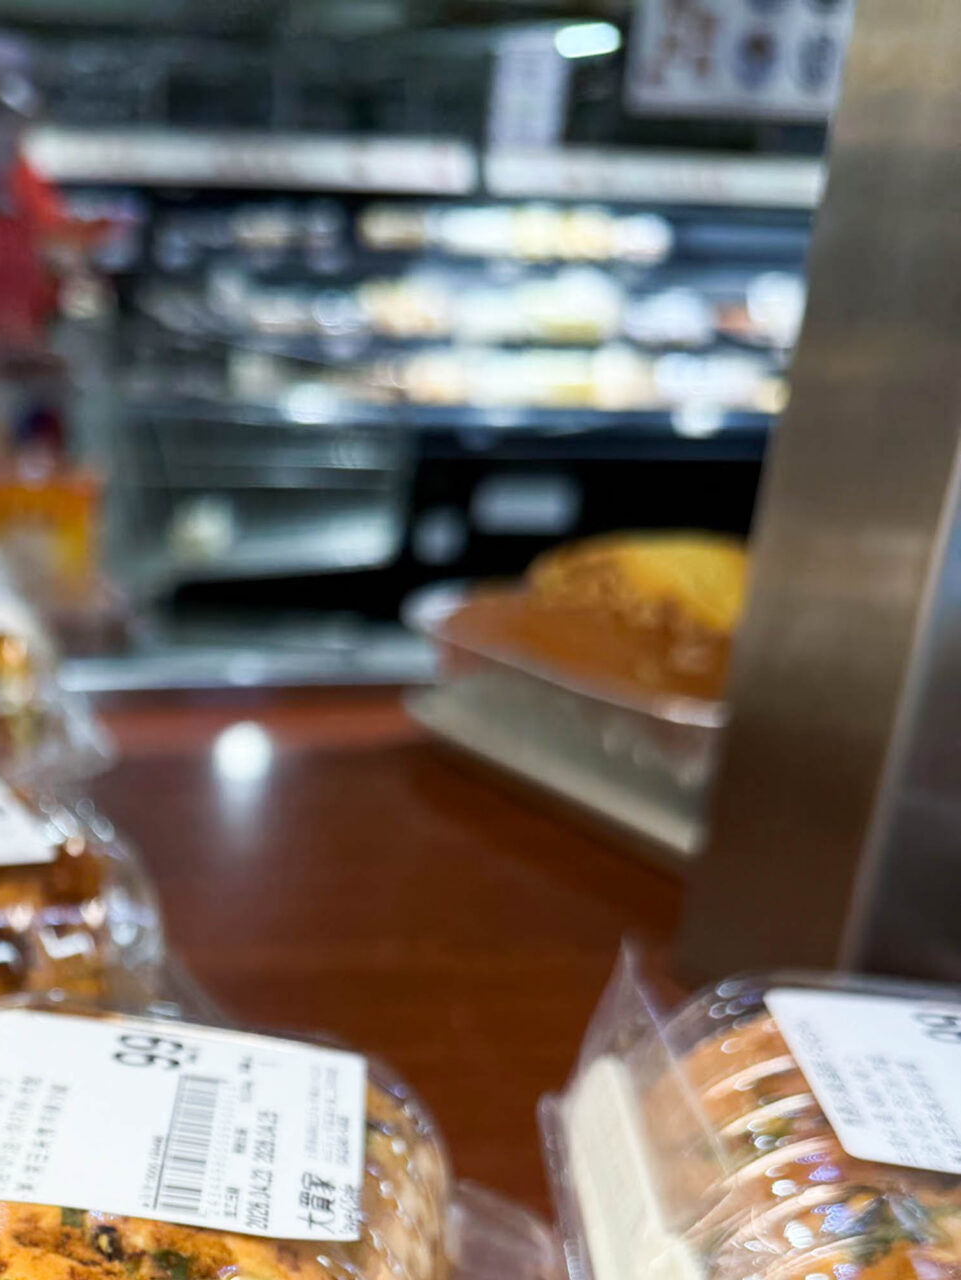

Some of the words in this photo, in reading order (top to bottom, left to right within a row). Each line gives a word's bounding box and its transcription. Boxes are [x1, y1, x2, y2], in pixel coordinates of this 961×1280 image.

[115, 1034, 183, 1071] 99
[297, 1171, 337, 1235] 大買家
